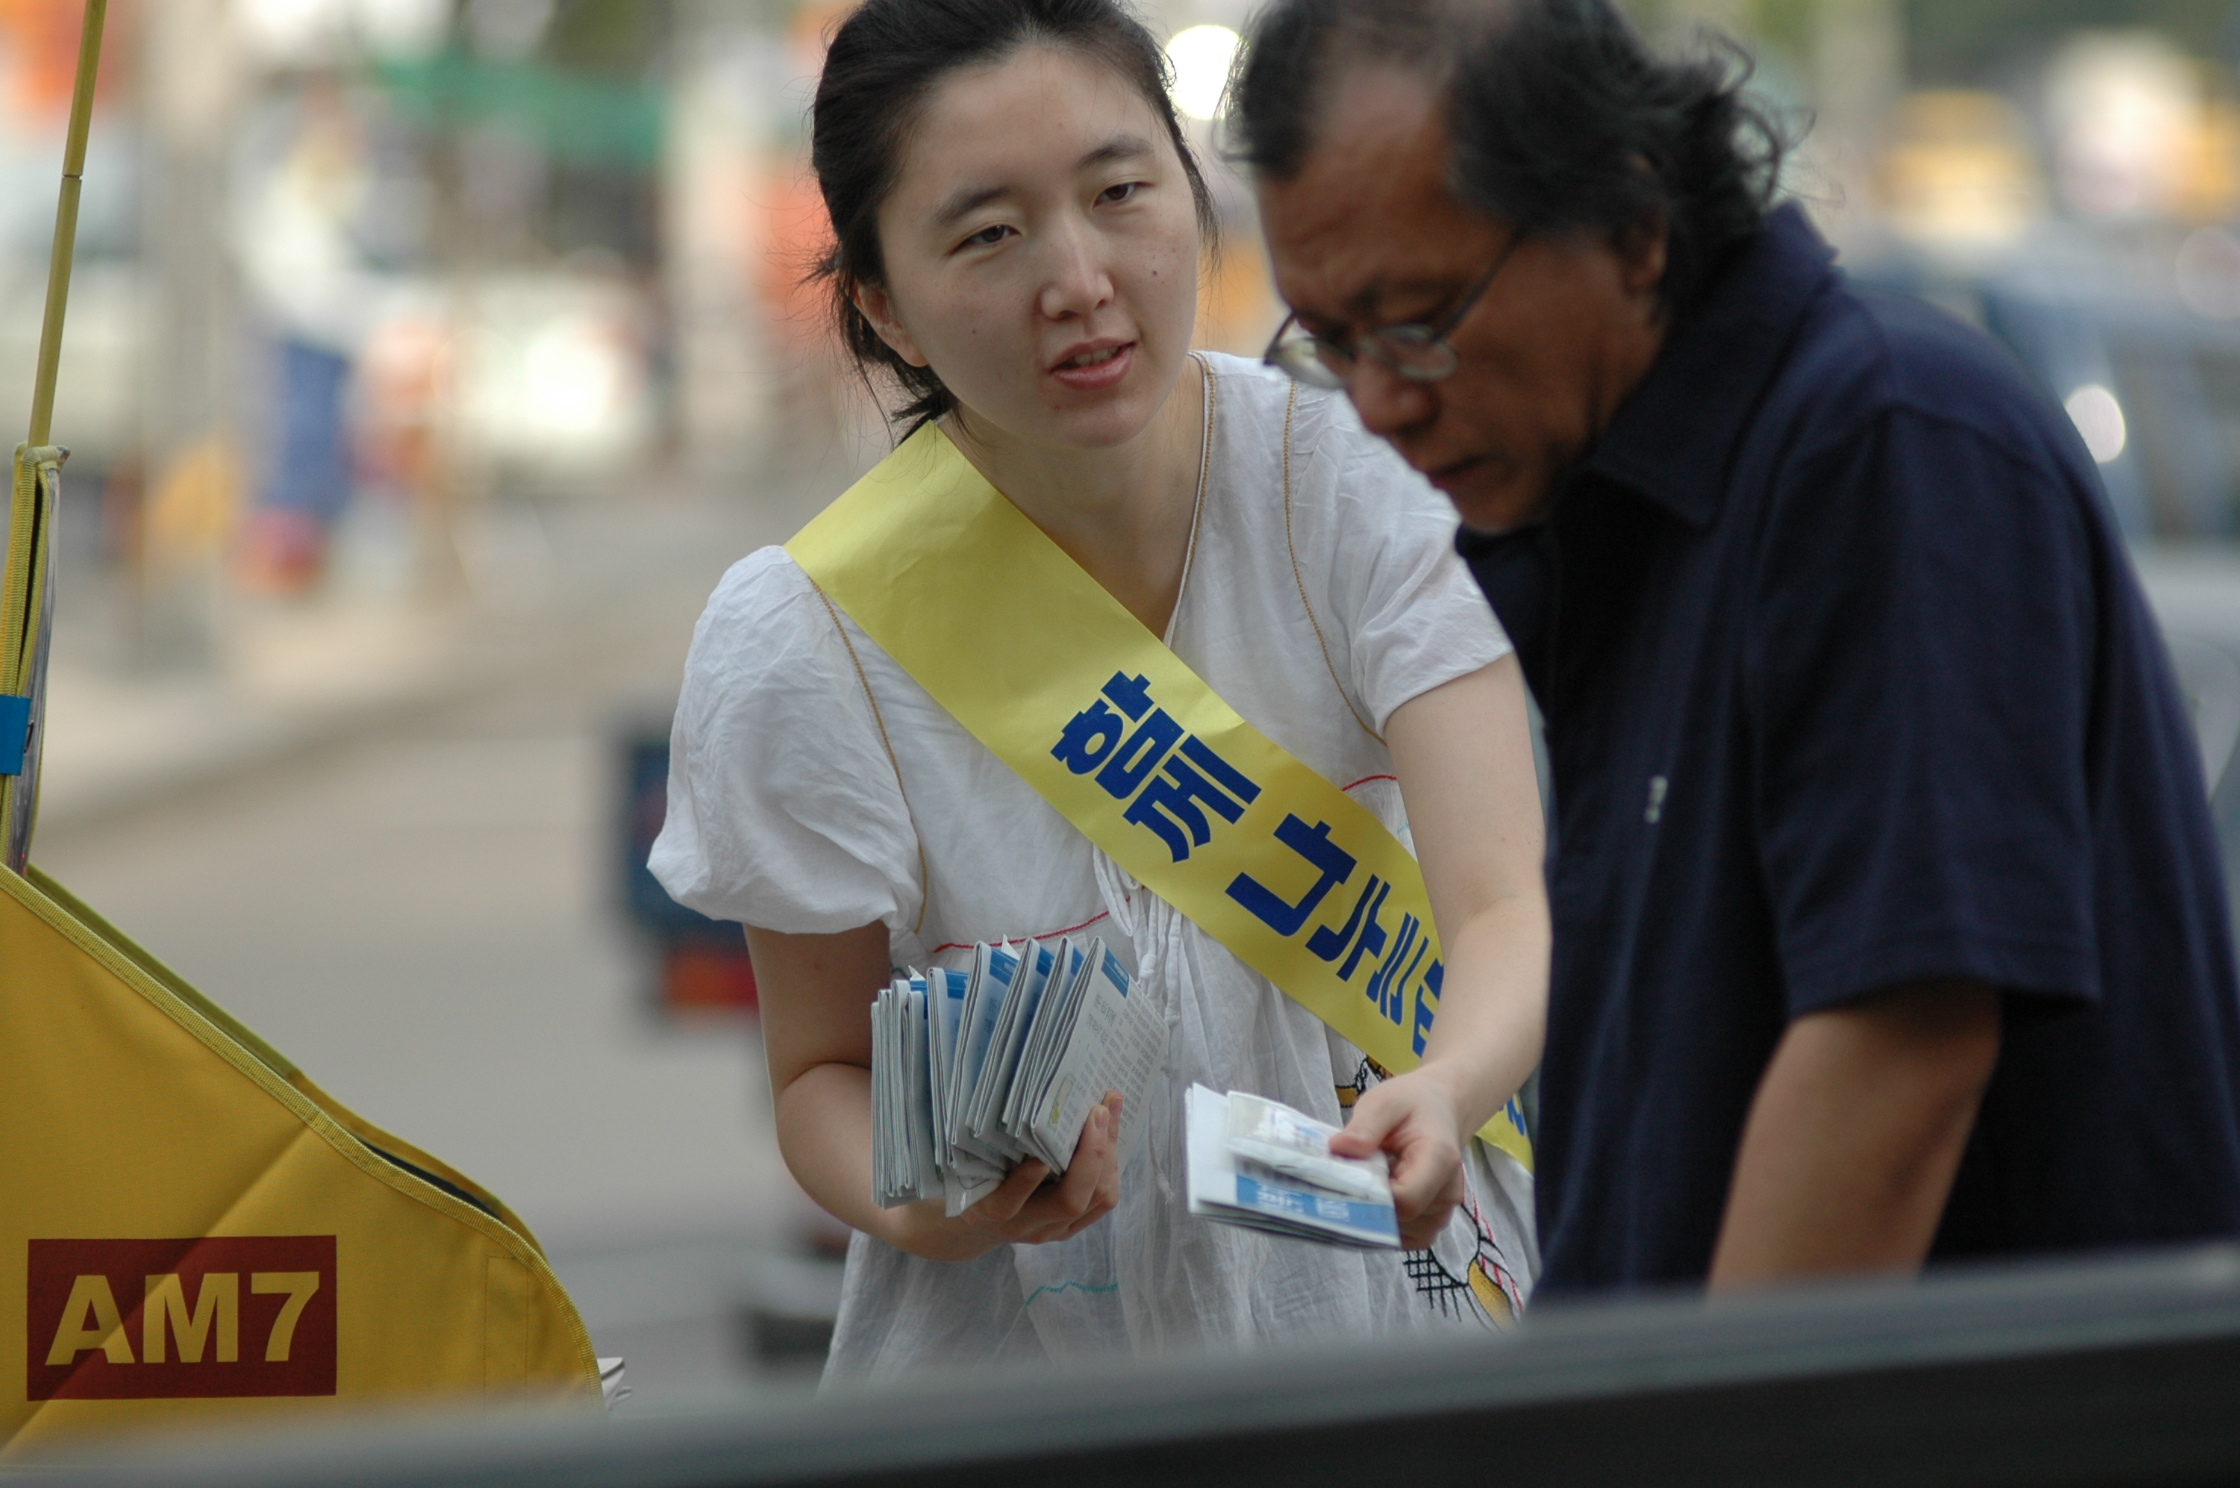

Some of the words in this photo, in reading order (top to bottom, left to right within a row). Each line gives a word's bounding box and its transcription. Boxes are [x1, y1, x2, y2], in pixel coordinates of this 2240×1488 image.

[1050, 670, 1262, 863] 함께
[1225, 812, 1430, 1026] 나누는
[45, 1271, 320, 1366] AM7
